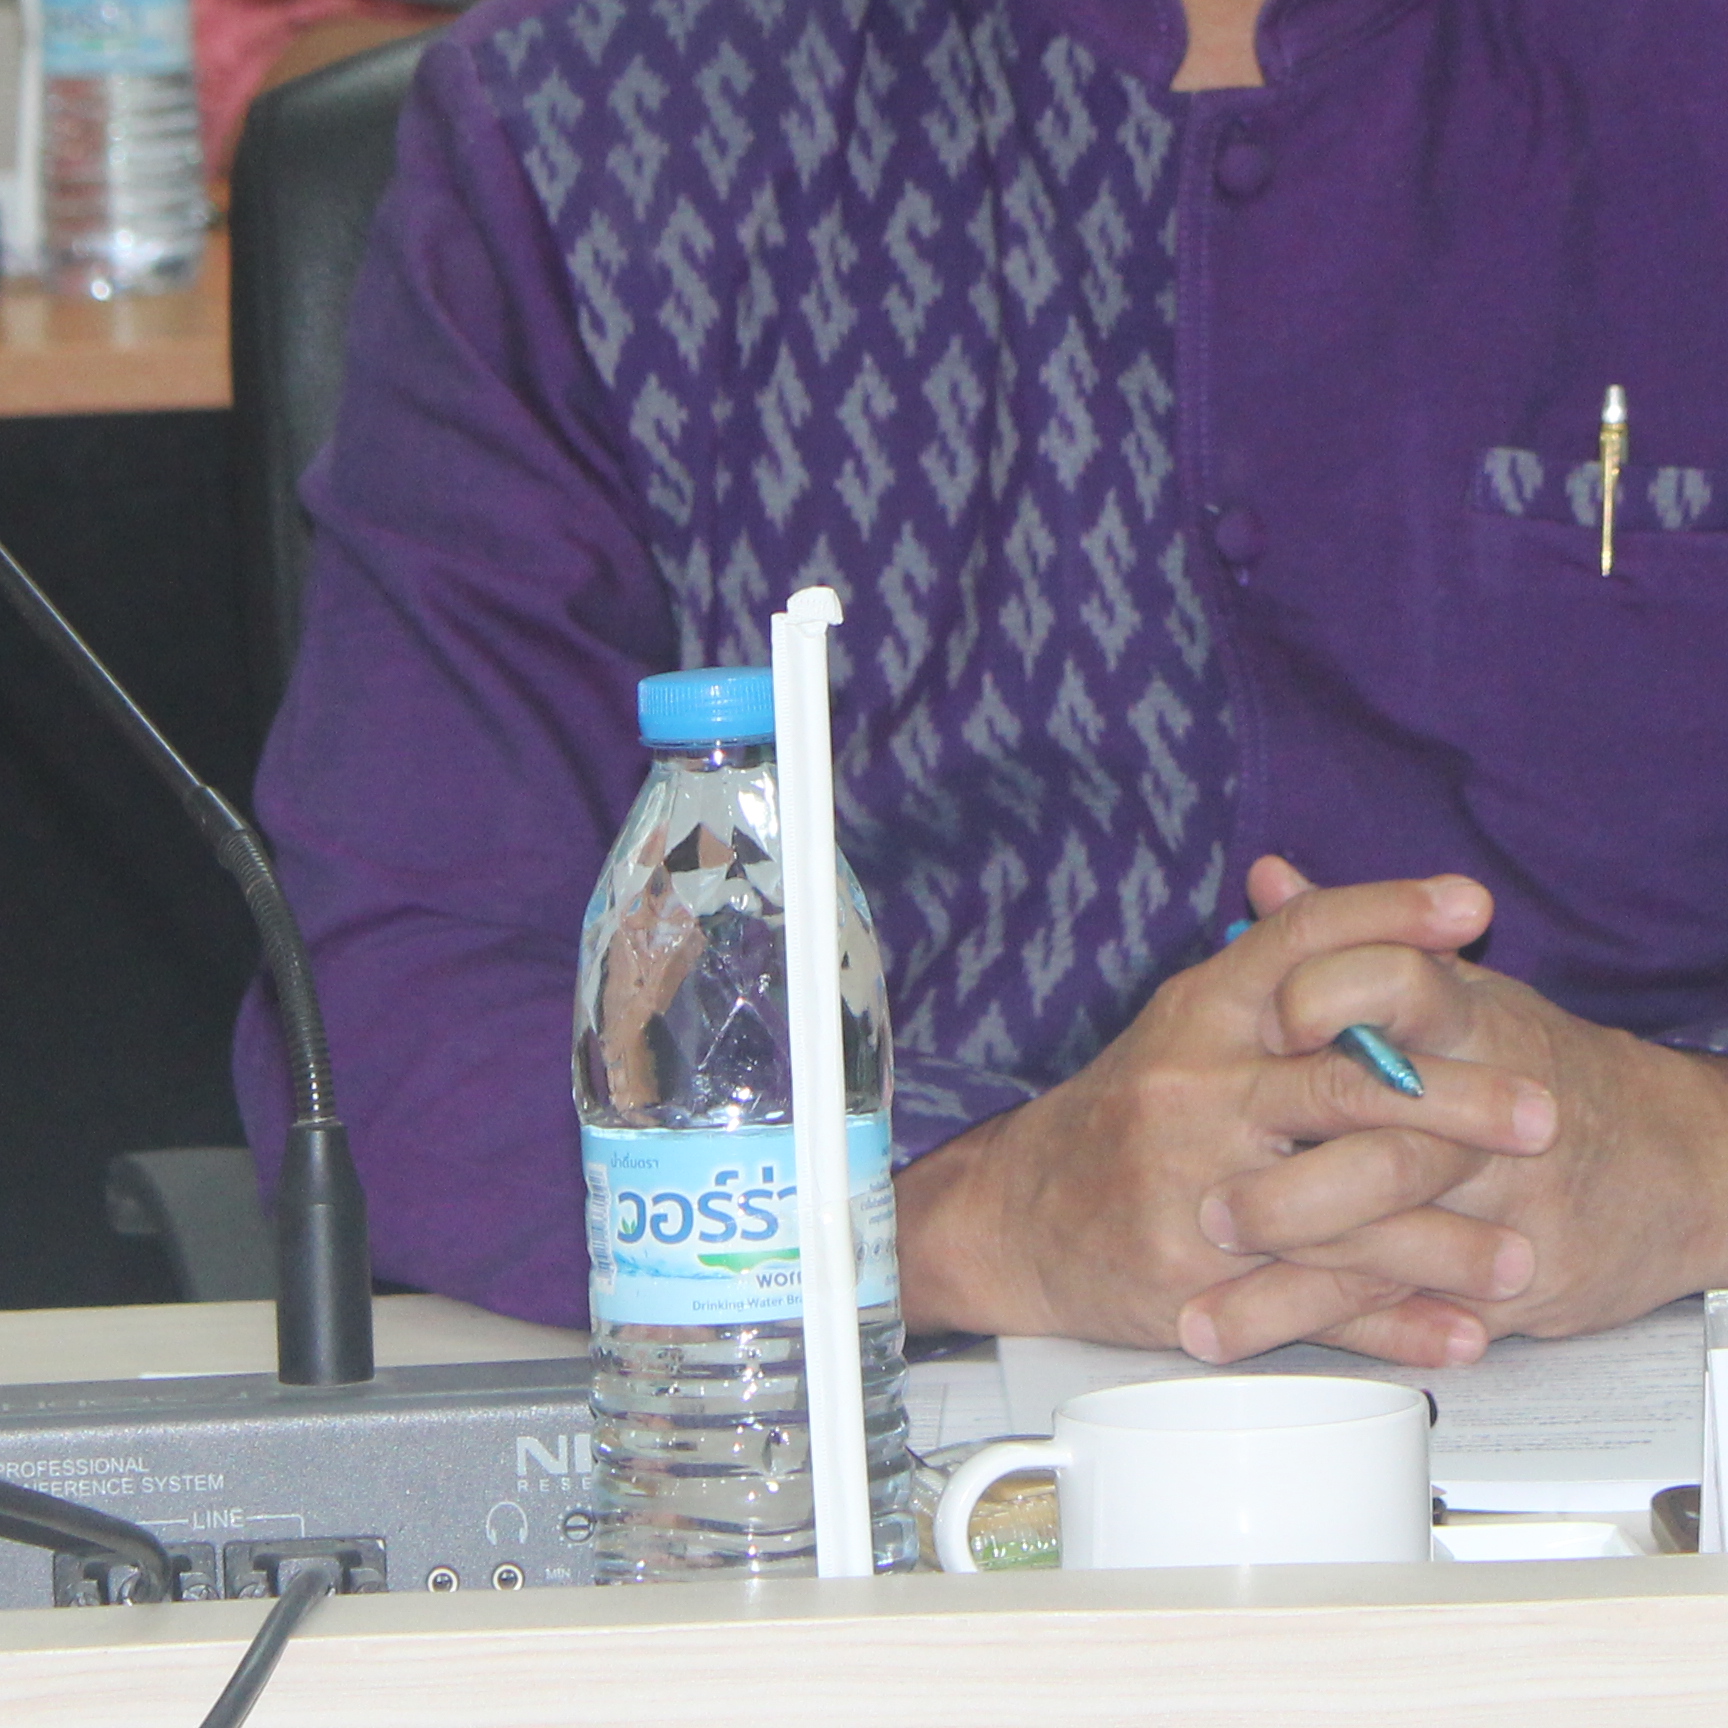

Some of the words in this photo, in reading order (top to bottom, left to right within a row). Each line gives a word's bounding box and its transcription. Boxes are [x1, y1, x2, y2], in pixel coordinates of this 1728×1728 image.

[692, 1299, 744, 1312] Drinking
[747, 1296, 783, 1309] Water
[141, 1473, 225, 1494] SYSTEM
[192, 1508, 246, 1530] LINE
